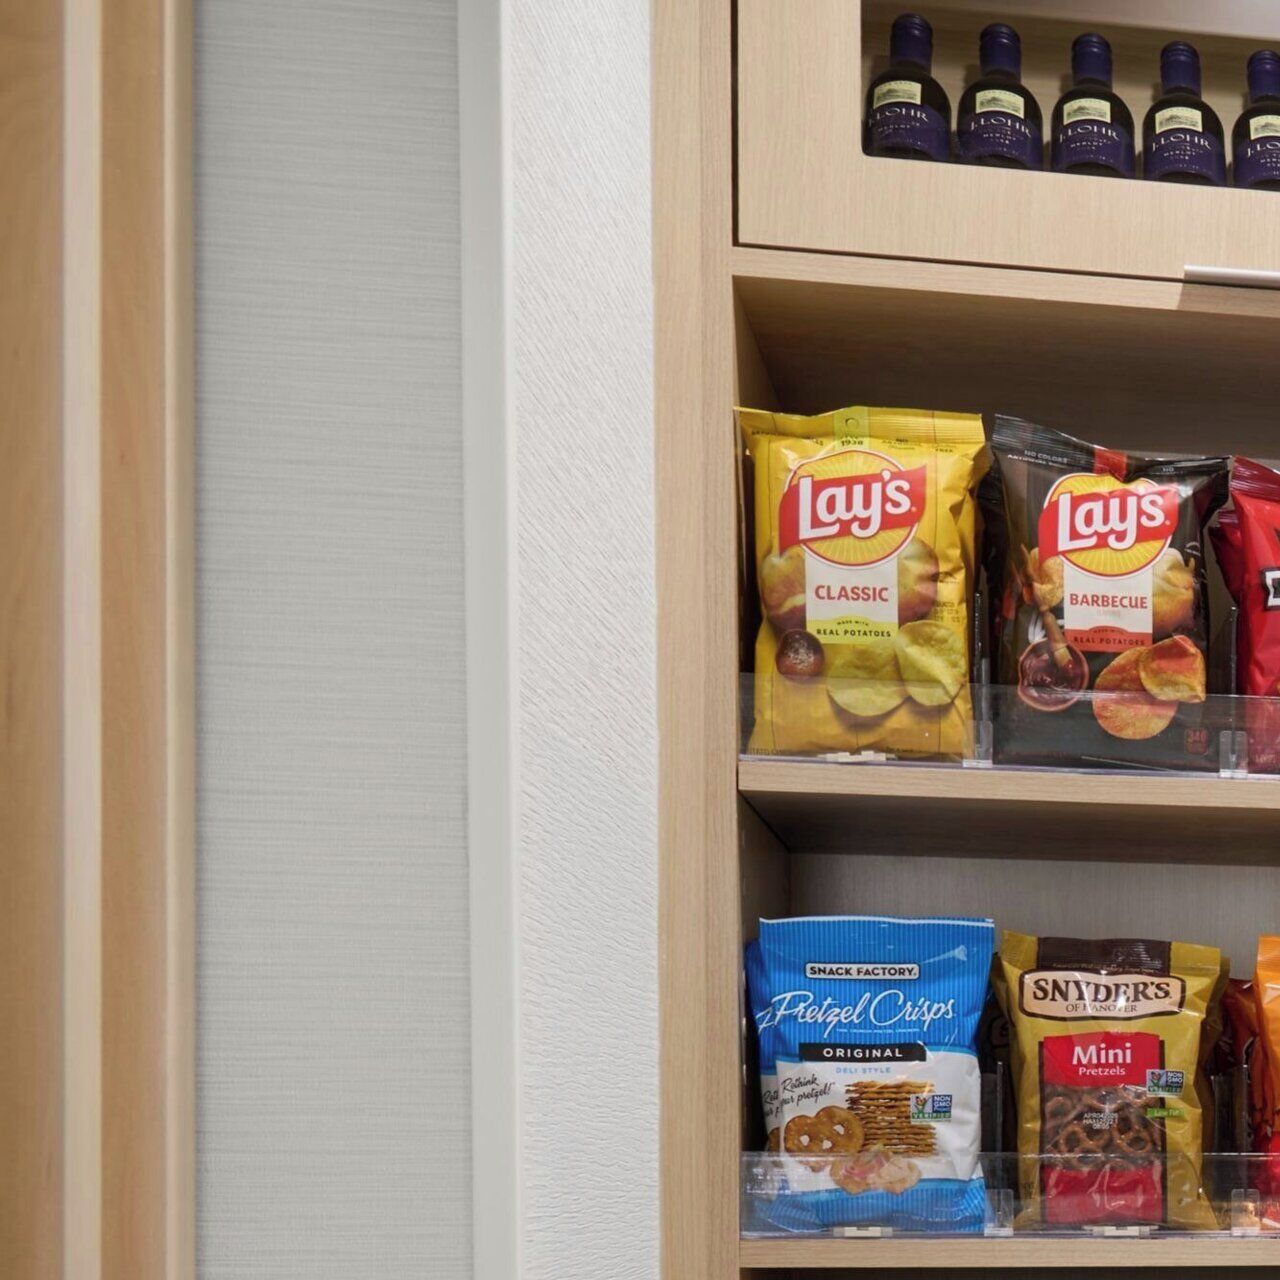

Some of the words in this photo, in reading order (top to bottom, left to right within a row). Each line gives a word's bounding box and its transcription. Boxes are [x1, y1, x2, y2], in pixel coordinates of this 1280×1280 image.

[800, 471, 911, 539] Lay's
[815, 585, 889, 603] CLASSIC
[1070, 593, 1148, 610] BARBECUE
[816, 628, 840, 637] REAL
[843, 628, 891, 638] POTATOES
[810, 966, 852, 977] SNACK
[856, 965, 916, 977] FACTORY
[1033, 978, 1170, 1002] SNYDER'S
[760, 993, 861, 1038] Pretzel
[870, 991, 954, 1030] Crisps
[1066, 1004, 1080, 1012] OF
[823, 1047, 903, 1058] ORIGINAL
[1072, 1043, 1131, 1065] Mini
[1079, 1067, 1125, 1075] Pretzels
